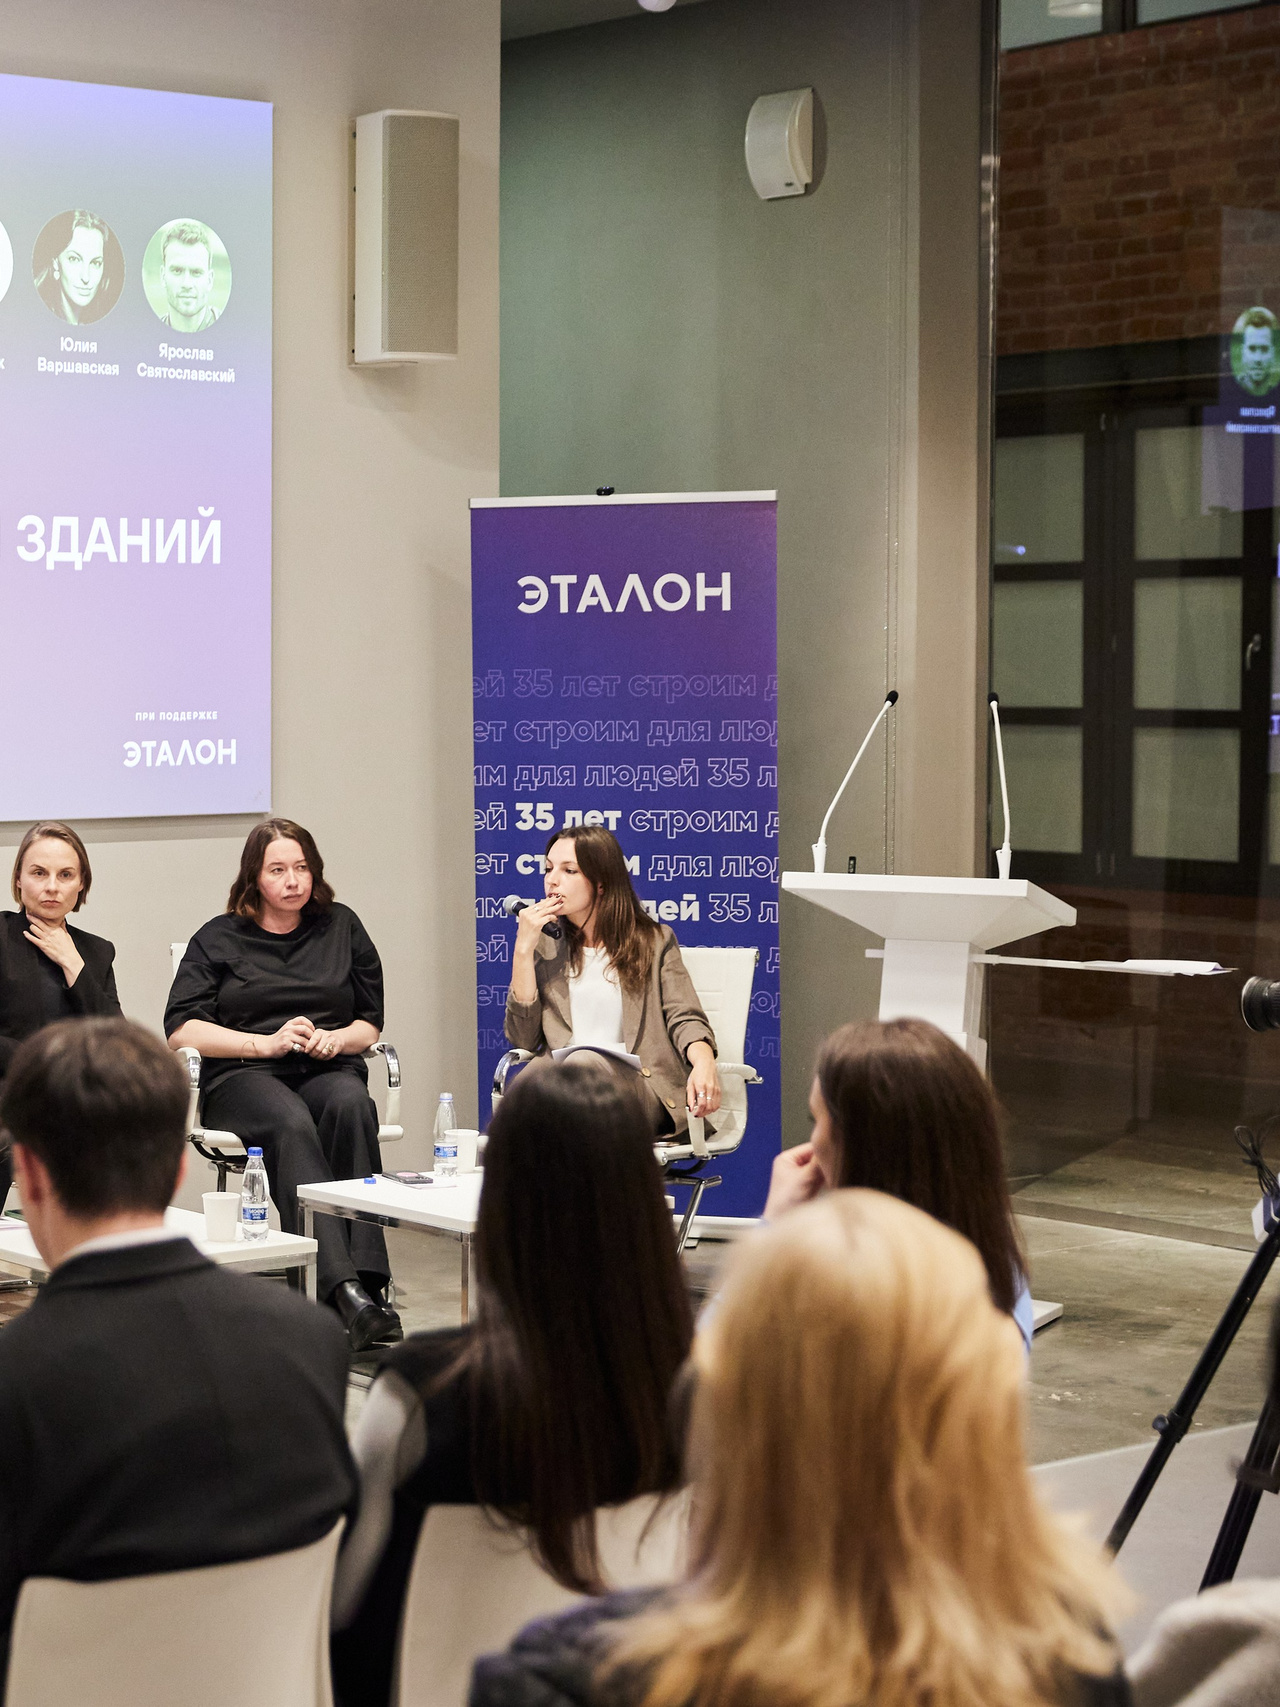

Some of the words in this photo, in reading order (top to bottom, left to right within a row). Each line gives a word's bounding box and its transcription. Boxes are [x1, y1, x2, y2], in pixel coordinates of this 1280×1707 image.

[60, 337, 97, 354] Юлия
[158, 344, 214, 362] Ярослав
[37, 357, 120, 377] Варшавская
[136, 363, 236, 384] Святославский
[16, 506, 221, 570] ЗДАНИЙ
[517, 571, 731, 614] ЭТАЛОН
[513, 669, 553, 698] 35
[560, 675, 620, 697] лет
[628, 675, 756, 703] строим
[135, 711, 156, 721] ПРИ
[159, 711, 218, 721] ПОДДЕРЖКЕ
[473, 720, 507, 742] ет
[514, 720, 639, 749] строим
[647, 720, 711, 747] для
[123, 738, 237, 767] ЭТАЛОН
[514, 765, 576, 791] для
[584, 758, 699, 791] людей
[708, 758, 750, 787] 35
[515, 802, 555, 831] 35
[563, 809, 622, 831] лет
[629, 810, 758, 839] строим
[474, 853, 508, 875] ет
[648, 855, 712, 881] для
[708, 894, 752, 923] 35
